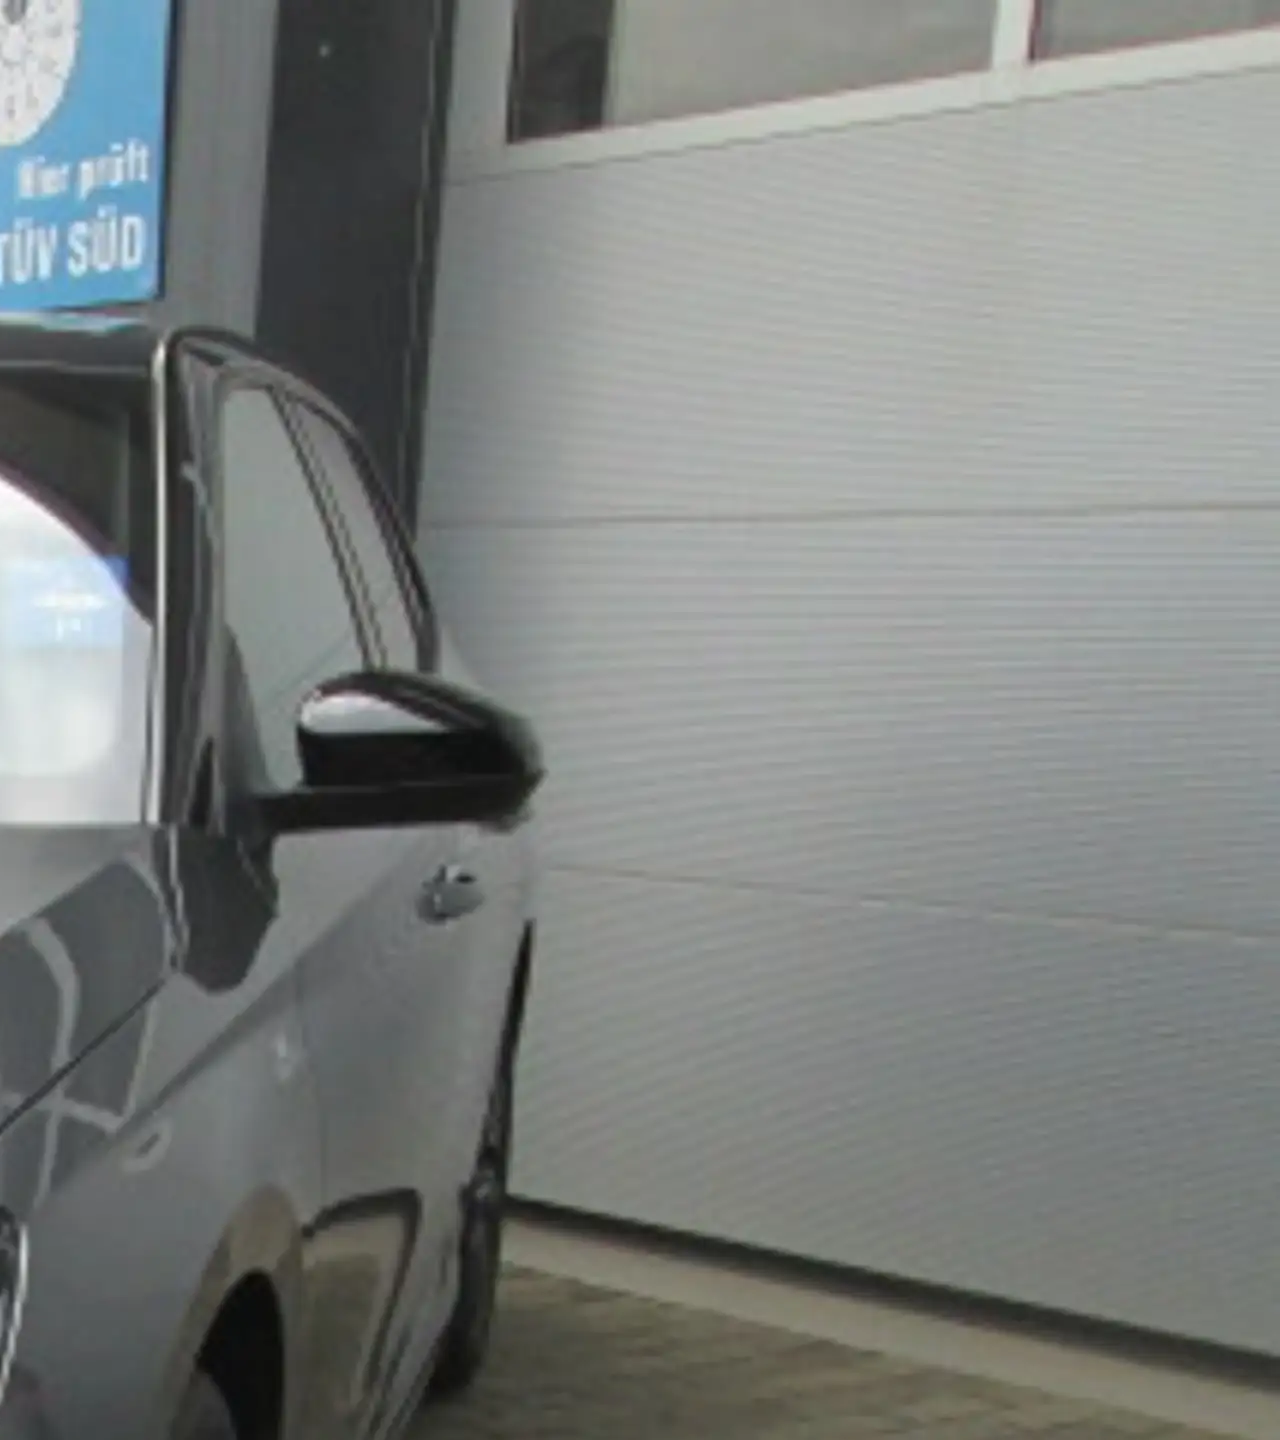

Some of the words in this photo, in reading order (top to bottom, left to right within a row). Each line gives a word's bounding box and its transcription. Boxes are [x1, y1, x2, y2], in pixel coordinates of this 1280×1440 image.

[17, 154, 70, 199] Hier
[78, 138, 150, 200] prüft
[66, 204, 146, 278] SÜD
